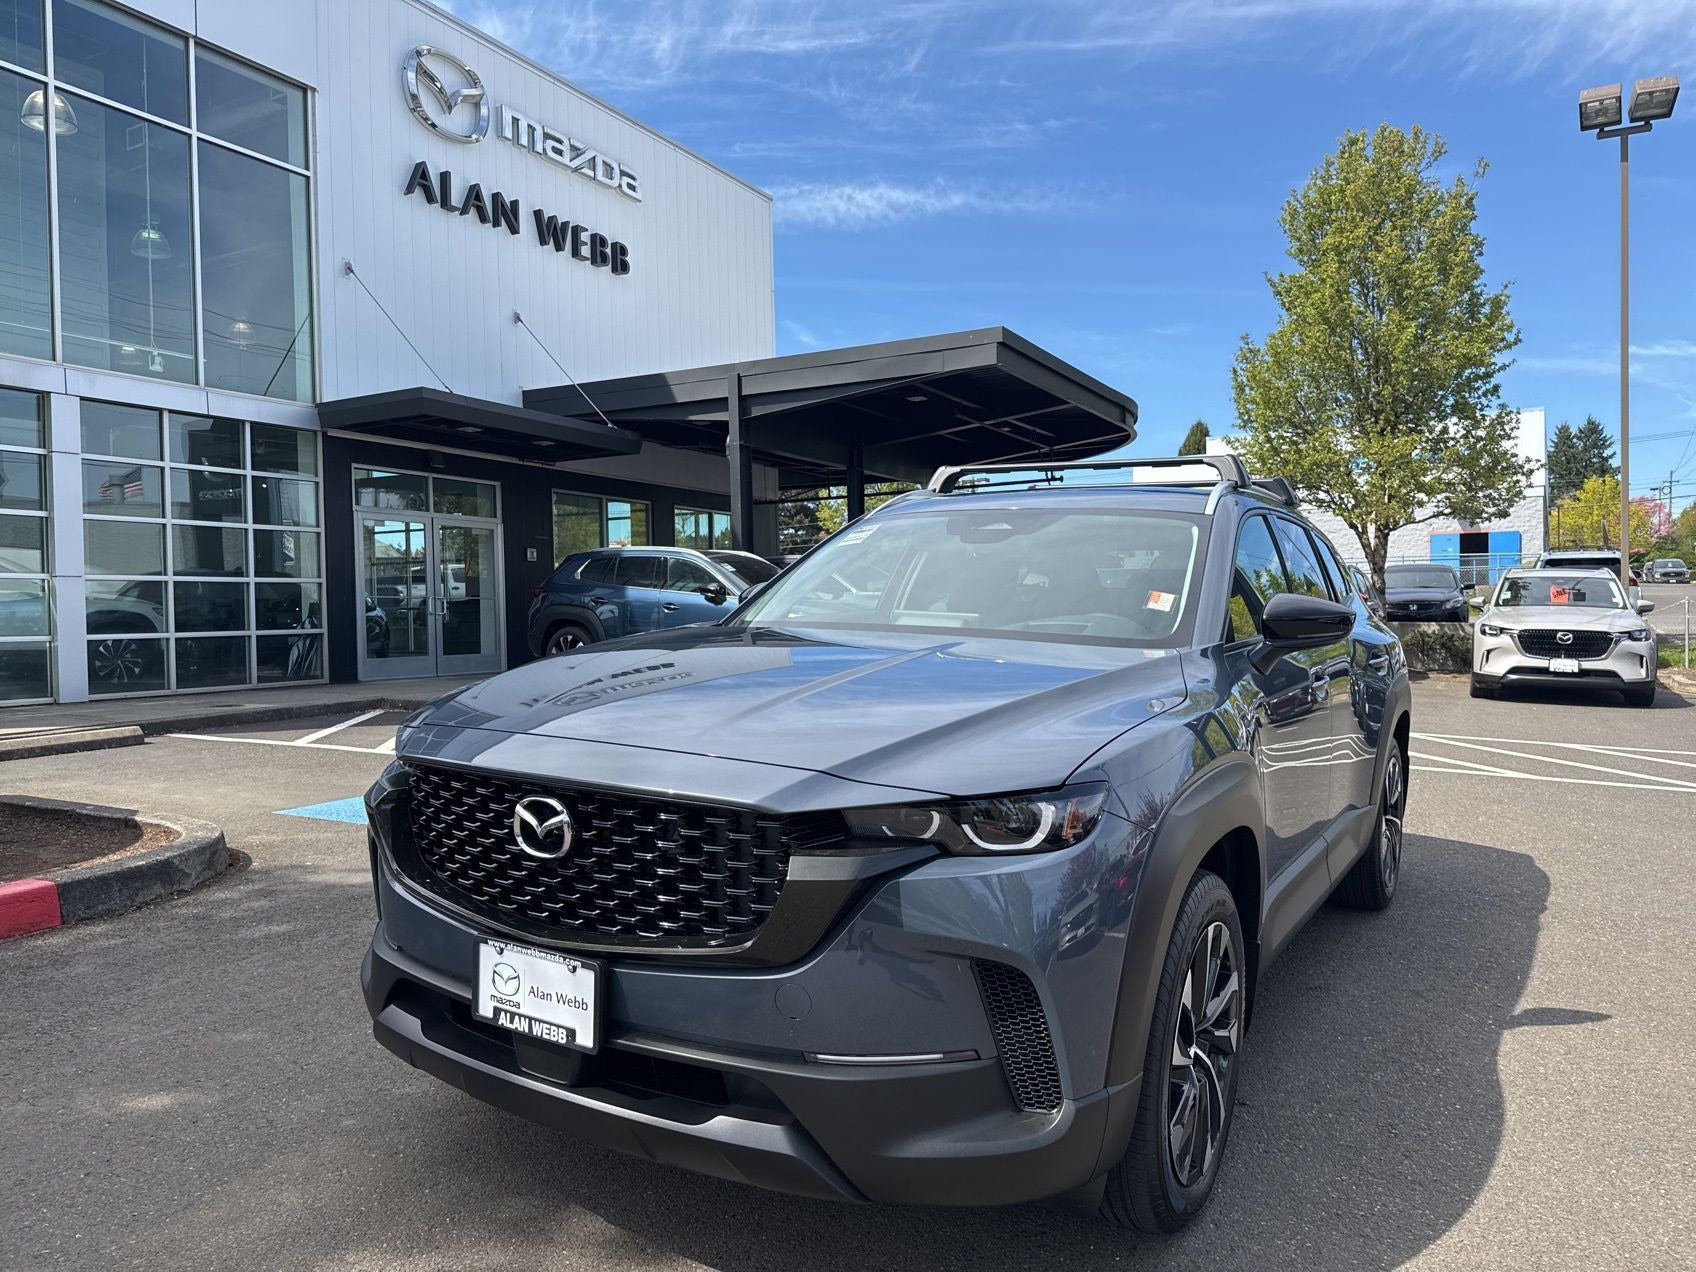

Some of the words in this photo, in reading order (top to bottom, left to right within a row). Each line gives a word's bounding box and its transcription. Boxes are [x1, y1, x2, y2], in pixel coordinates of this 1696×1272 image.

[496, 104, 642, 202] mazda
[403, 161, 521, 235] ALAN
[533, 208, 631, 276] WEBB
[1552, 588, 1568, 599] SALE
[487, 939, 582, 968] www.alanwebbmazda.com
[490, 994, 521, 1010] mazda
[528, 985, 553, 1003] Alan
[555, 991, 589, 1012] Webb
[498, 1010, 529, 1033] ALAN
[531, 1019, 567, 1044] WEBB
